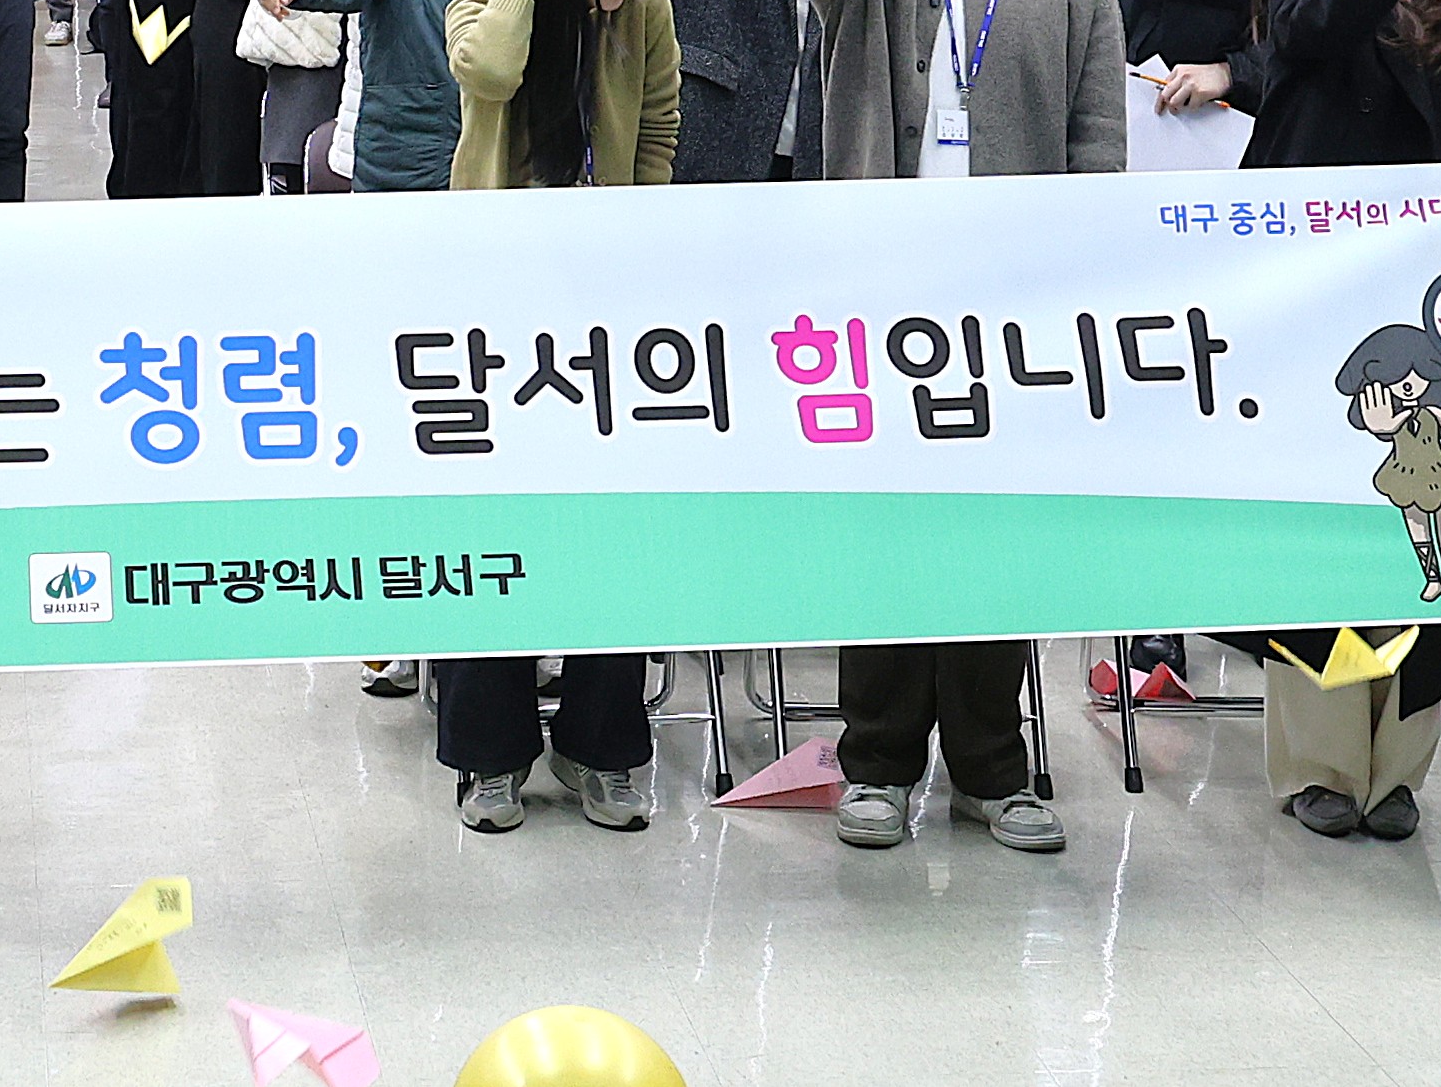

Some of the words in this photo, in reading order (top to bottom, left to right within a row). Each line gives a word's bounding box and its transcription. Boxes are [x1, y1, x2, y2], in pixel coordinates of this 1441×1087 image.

[1160, 204, 1219, 234] 대구
[1228, 201, 1297, 236] 중심,
[1305, 200, 1389, 234] 달서의
[99, 331, 358, 467] 청렴,
[395, 323, 730, 455] 달서의
[771, 307, 1260, 444] 힘입니다.
[124, 557, 363, 606] 대구광역시
[379, 553, 527, 599] 달서구
